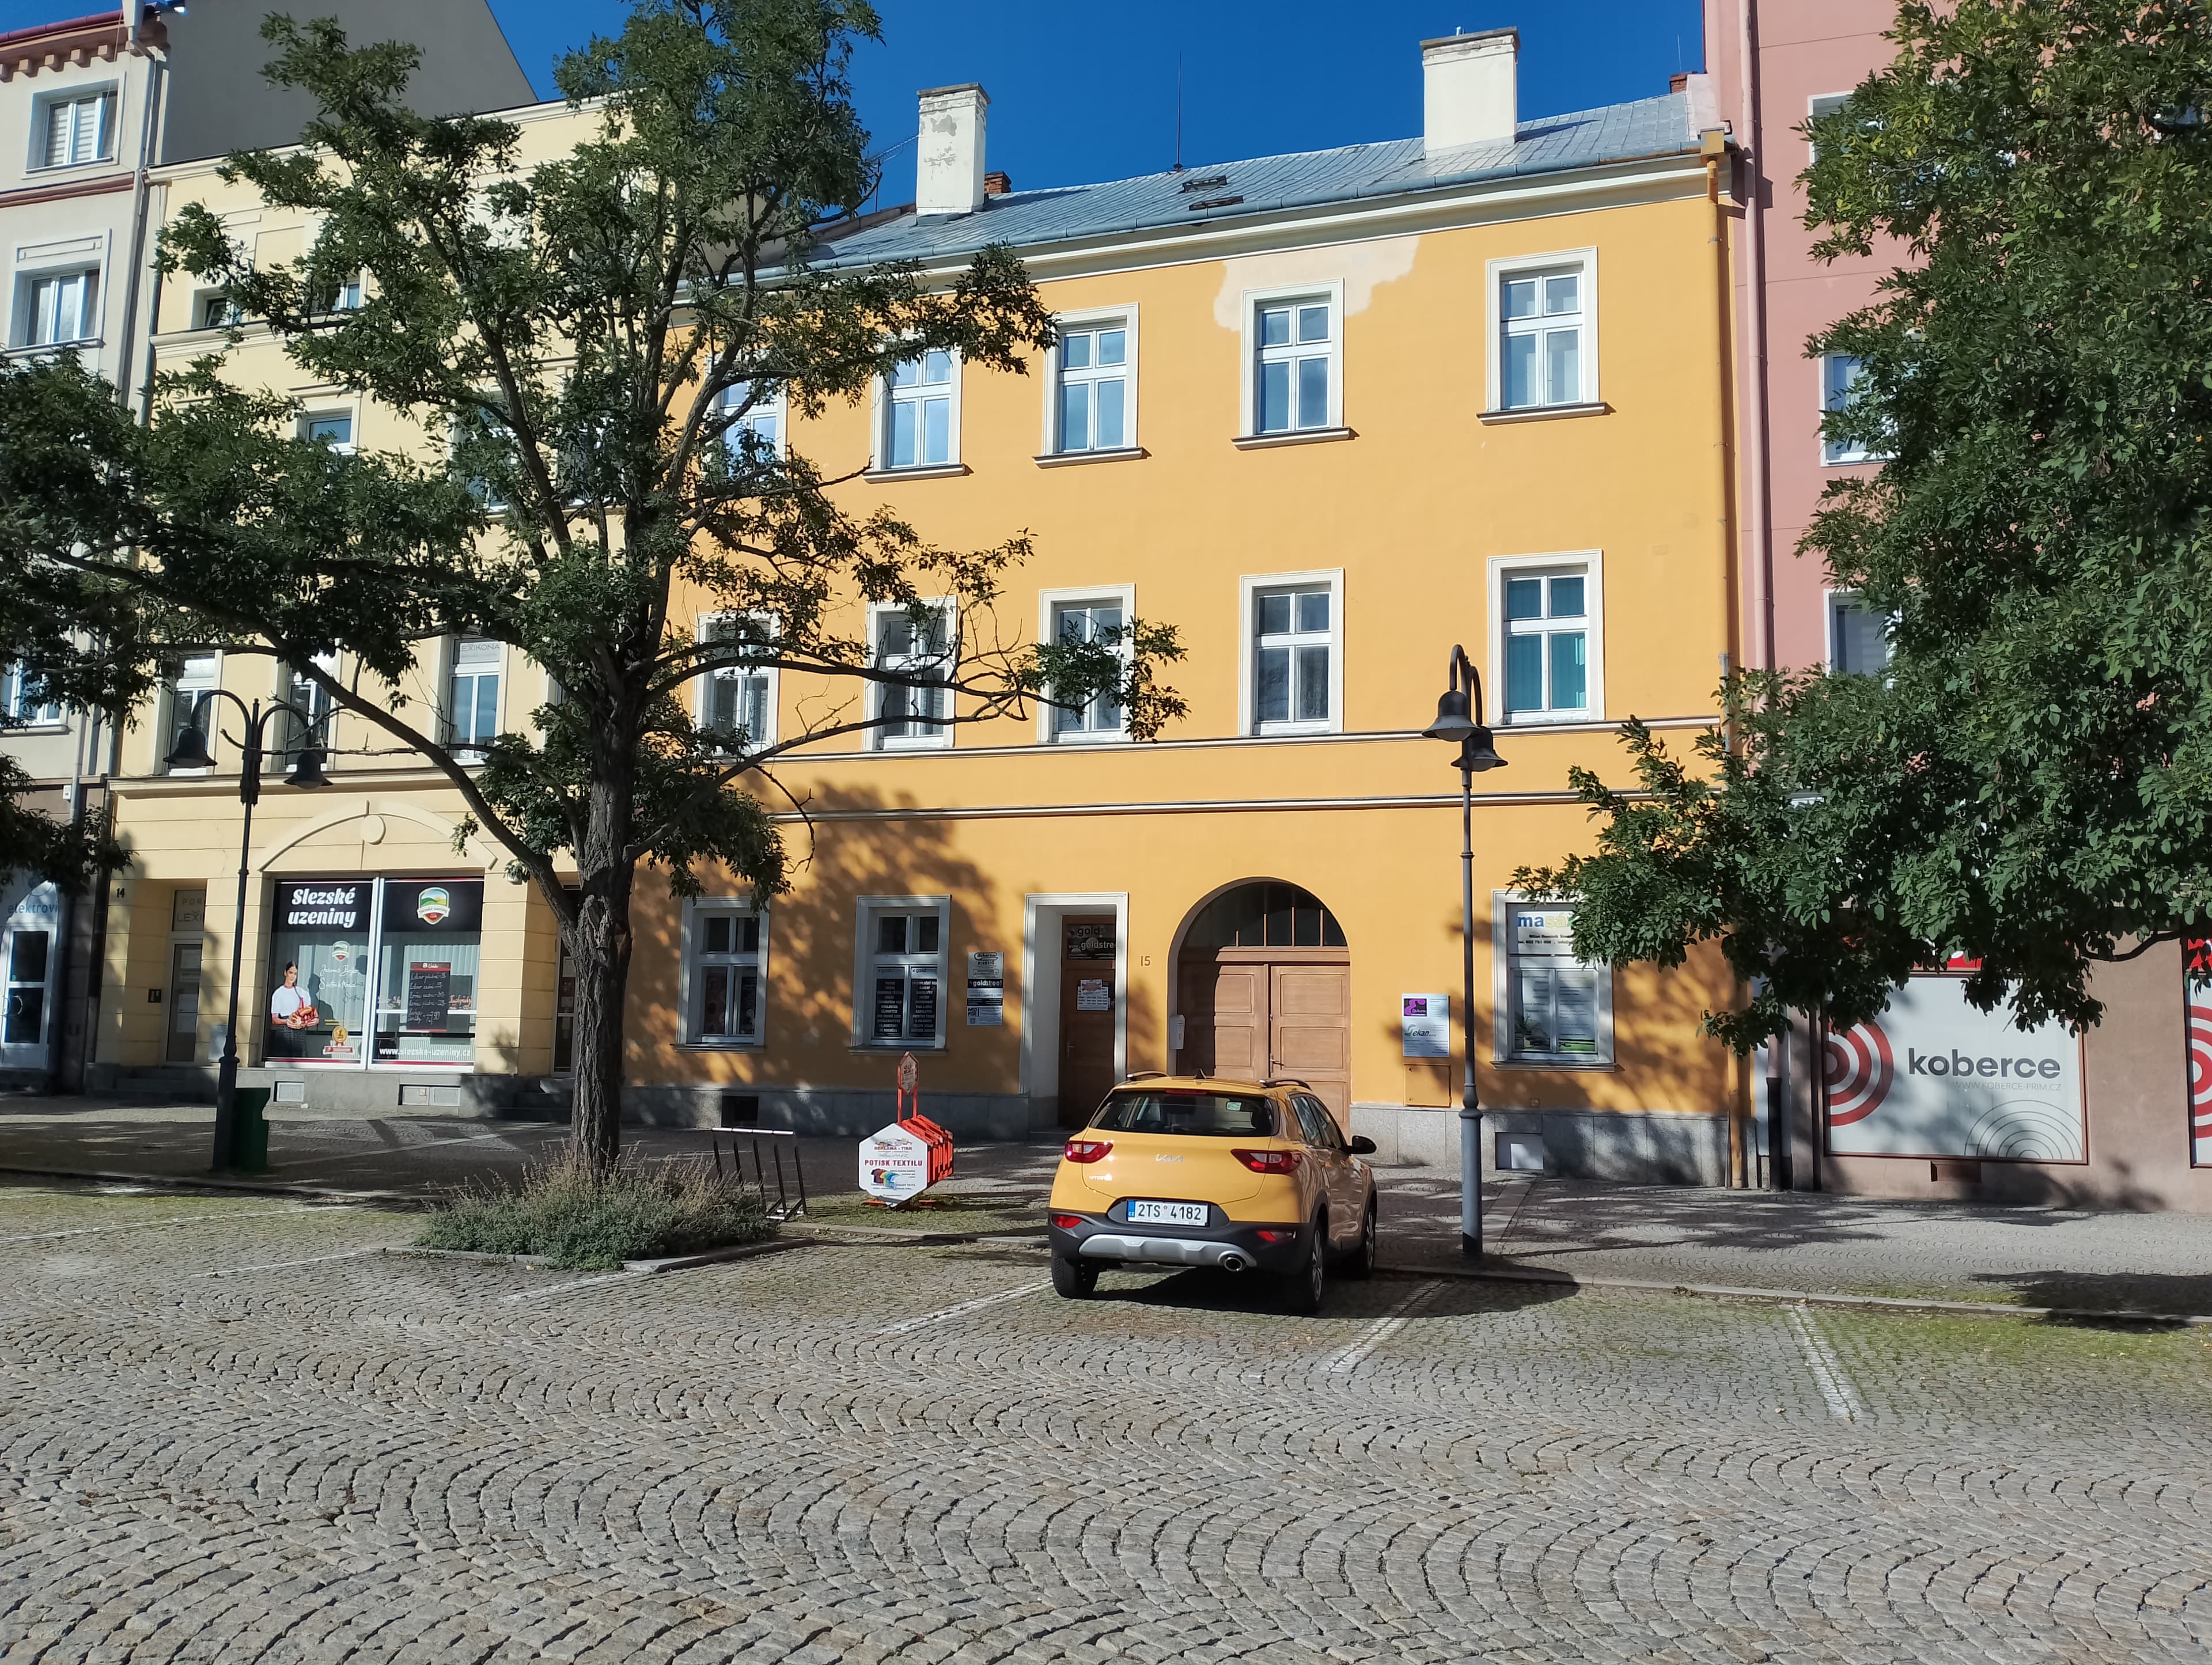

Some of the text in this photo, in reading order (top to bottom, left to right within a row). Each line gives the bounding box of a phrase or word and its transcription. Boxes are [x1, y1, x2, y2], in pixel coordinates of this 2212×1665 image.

[116, 888, 125, 898] 14
[291, 887, 356, 905] Slezské
[288, 908, 357, 928] uzeniny
[1141, 955, 1151, 966] 15
[379, 1048, 471, 1059] www.slezske-uzeniny.cz
[1908, 1048, 2061, 1079] koberce
[1953, 1081, 2062, 1091] WWW.KOBERCE-PRIM.CZ
[1138, 1204, 1201, 1220] 2TS 4182
